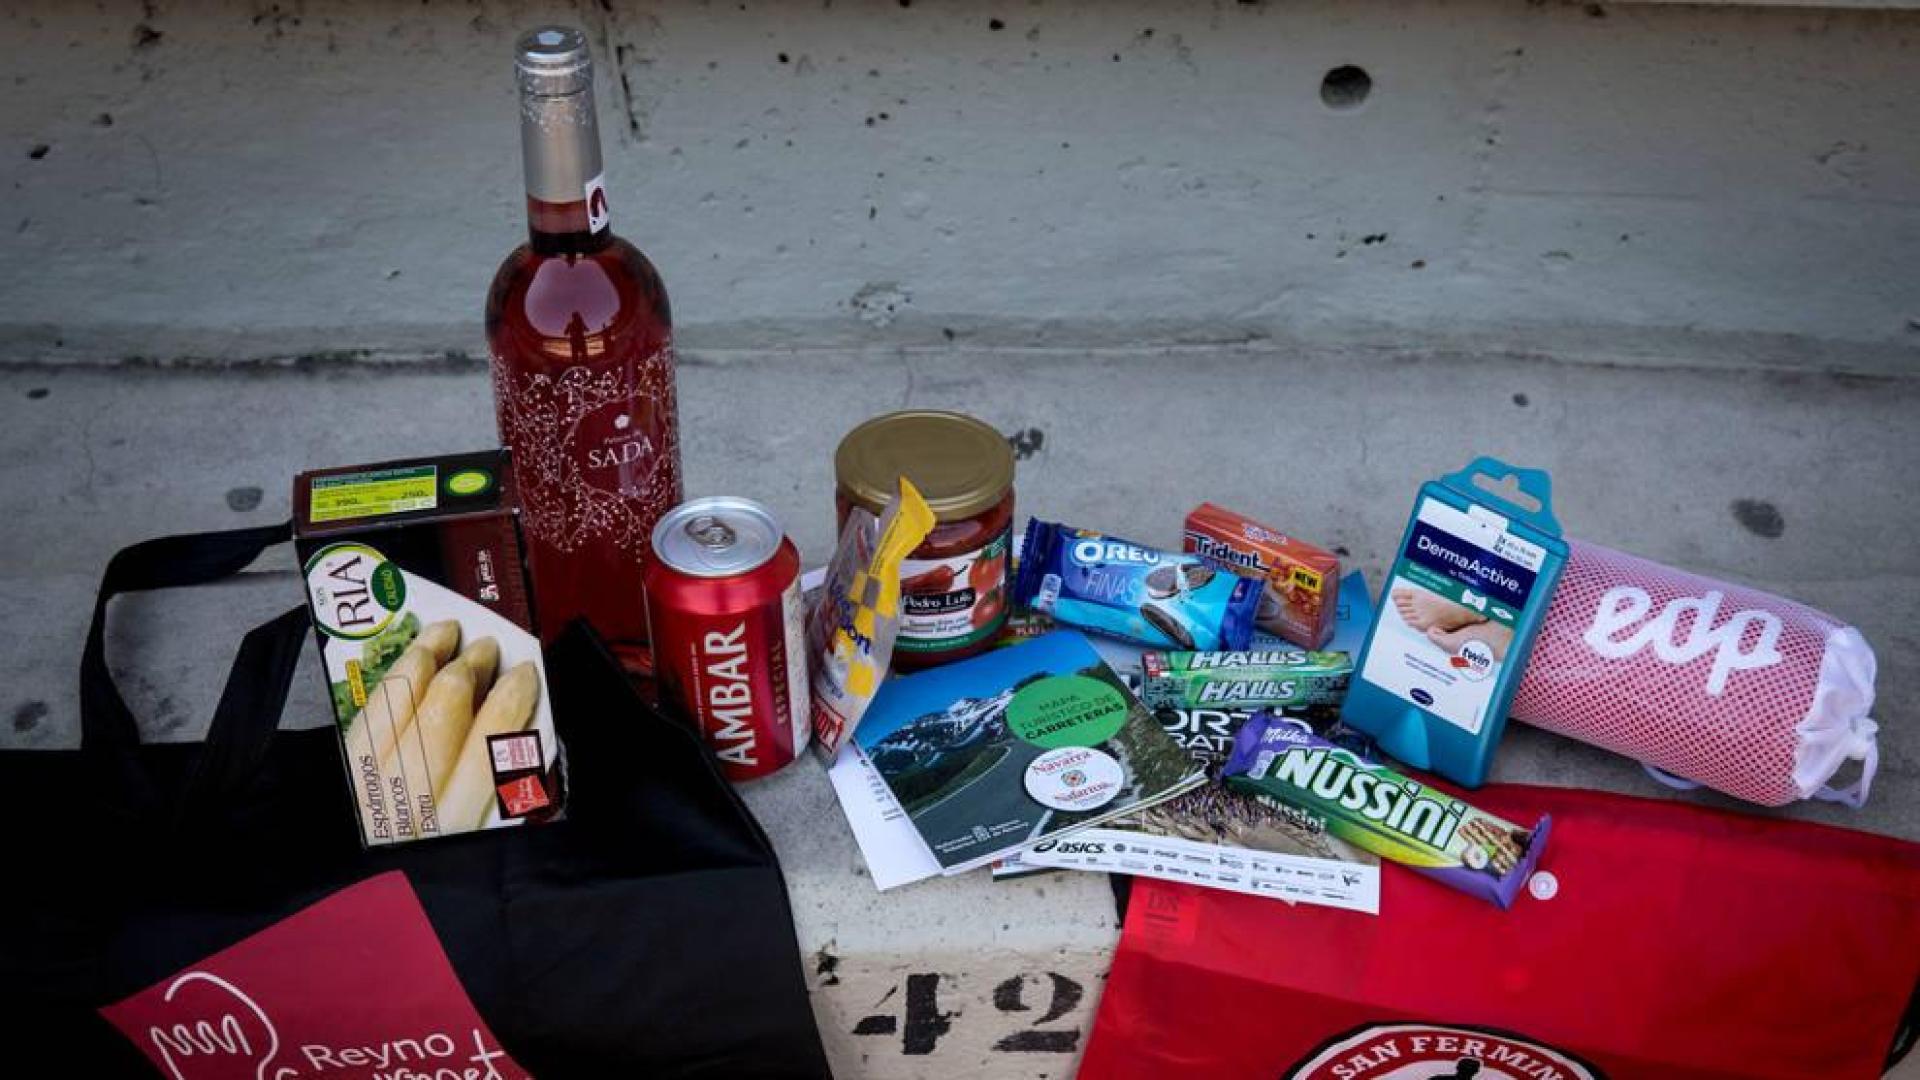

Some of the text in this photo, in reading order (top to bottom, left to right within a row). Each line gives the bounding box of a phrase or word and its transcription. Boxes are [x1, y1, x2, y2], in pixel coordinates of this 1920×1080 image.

[588, 436, 653, 468] SADA
[1196, 533, 1262, 570] Trident
[1416, 534, 1521, 592] DermaActive
[327, 555, 375, 629] RIA
[1294, 570, 1319, 589] NEW
[1190, 650, 1308, 669] HALLS
[1461, 646, 1491, 669] twin
[1583, 585, 1784, 696] edp
[703, 622, 758, 766] AMBAR
[1200, 679, 1298, 702] HALLS
[1025, 702, 1125, 741] CARRETERAS
[389, 776, 414, 837] Blancos
[417, 793, 438, 833] Extra
[1057, 840, 1106, 855] asics
[852, 971, 1084, 1056] 42
[301, 1031, 457, 1072] Reyno
[1331, 1039, 1402, 1080] SAN
